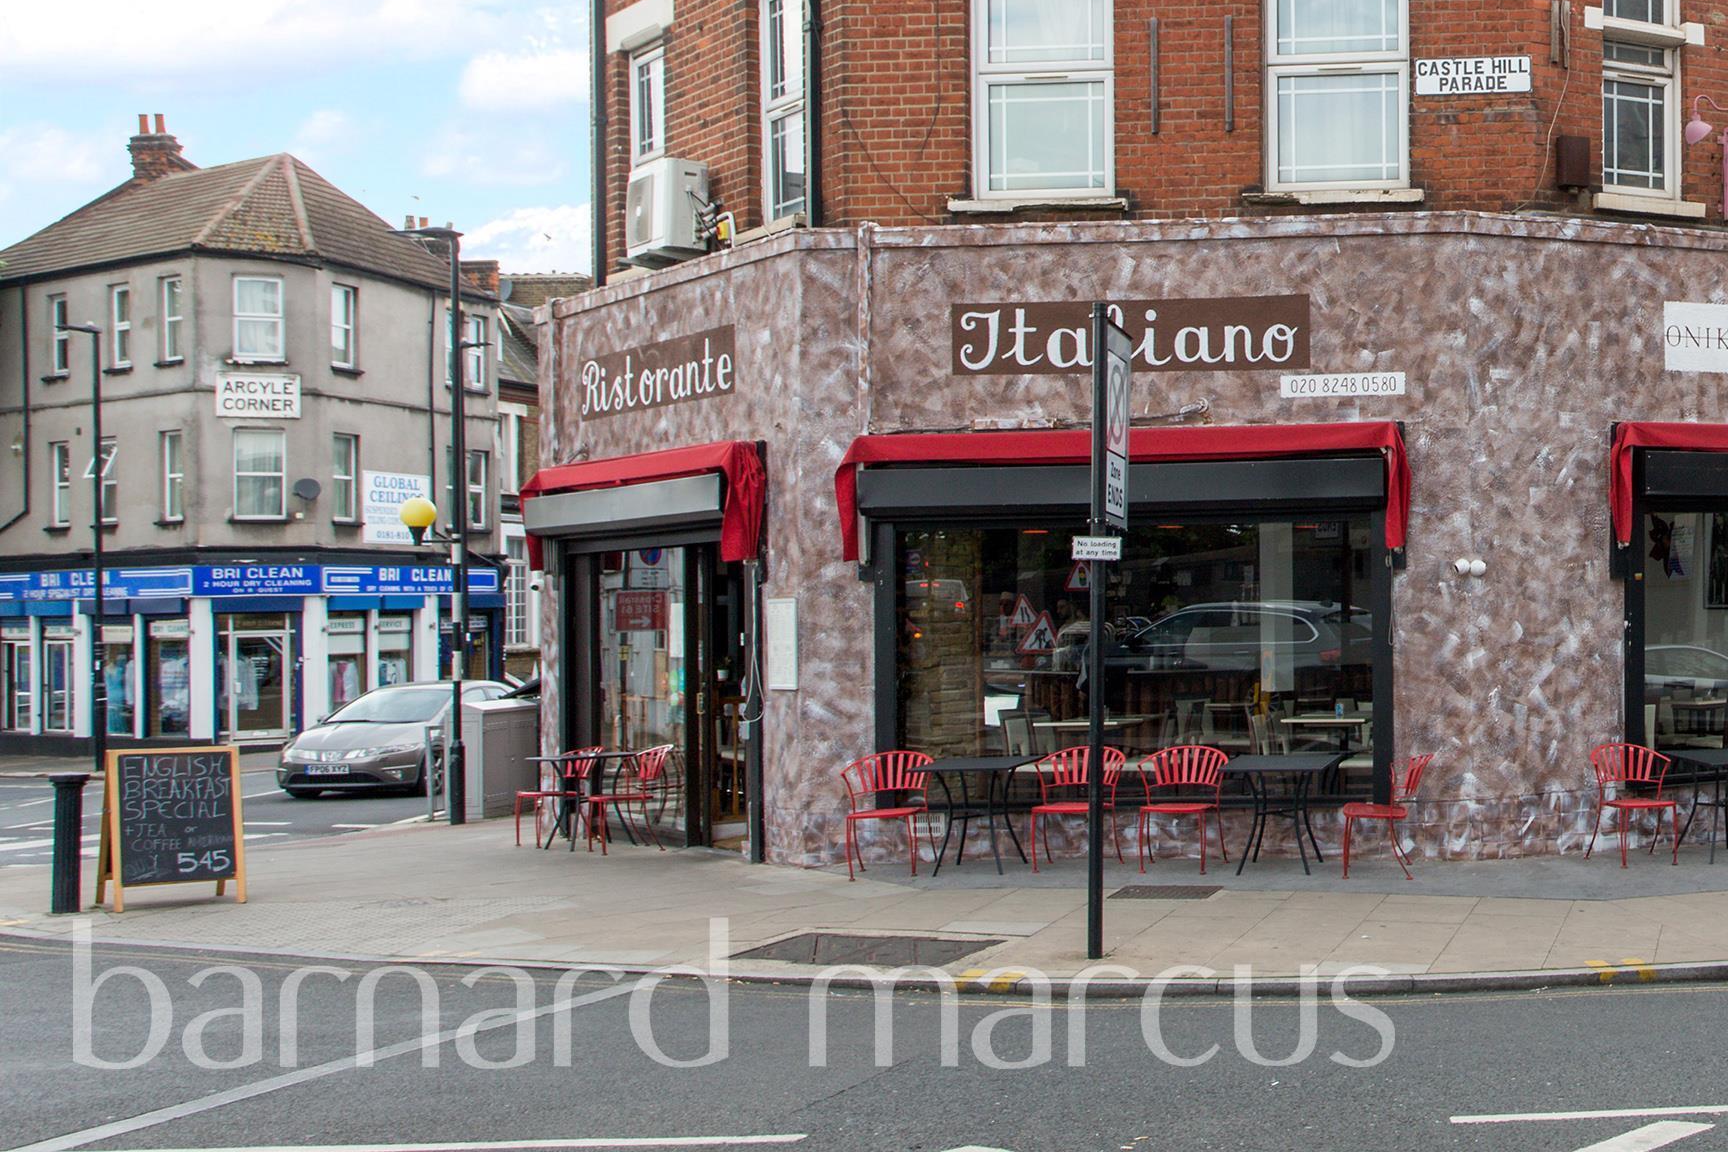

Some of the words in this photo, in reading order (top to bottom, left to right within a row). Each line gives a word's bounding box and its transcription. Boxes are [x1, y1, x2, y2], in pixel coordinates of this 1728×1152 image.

[1417, 60, 1485, 77] CASTLE
[1491, 58, 1528, 74] HILL
[1439, 76, 1508, 92] PARADE
[582, 338, 732, 415] Ristorante
[1290, 378, 1317, 393] 020
[1322, 377, 1357, 393] 8248
[1362, 376, 1397, 392] 0580
[223, 398, 294, 411] CORNER
[1110, 461, 1121, 481] Zone
[374, 475, 420, 491] GLOBAL
[1108, 483, 1123, 509] ENDS
[1090, 540, 1117, 548] loading
[41, 573, 60, 587] BRI
[70, 571, 111, 586] CLEN
[212, 568, 240, 579] BRI
[246, 567, 304, 579] CLEAN
[379, 567, 400, 581] BRI
[411, 568, 452, 582] CLEAN
[212, 580, 240, 588] HOUR
[264, 579, 312, 587] CLEANING
[124, 756, 225, 779] ENGLISH
[124, 777, 232, 800] BREAKFAST
[124, 799, 226, 821] SPECIAL
[131, 838, 182, 852] COFFEE
